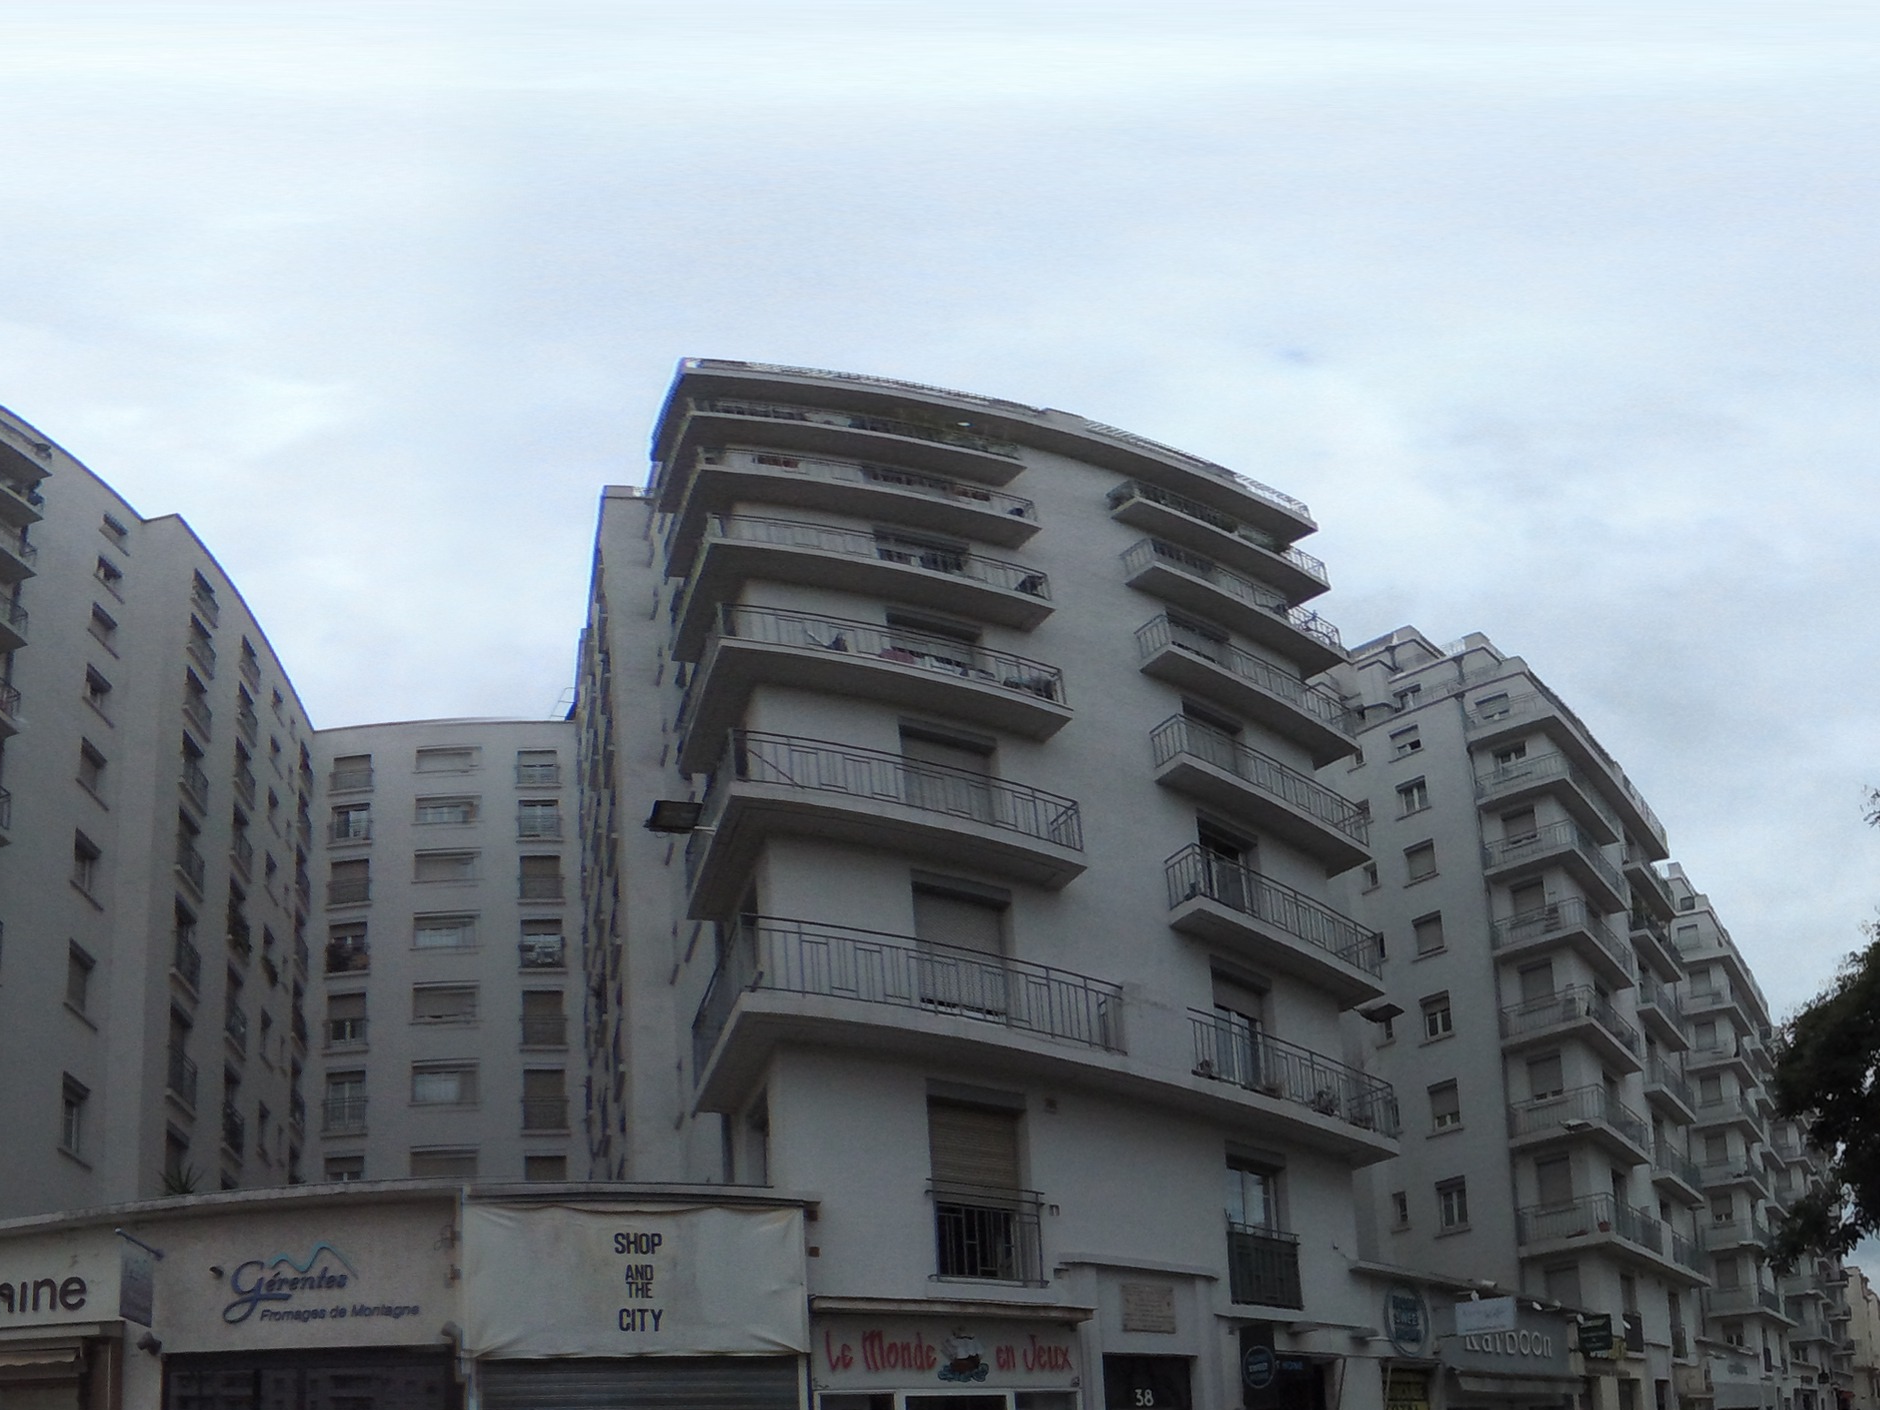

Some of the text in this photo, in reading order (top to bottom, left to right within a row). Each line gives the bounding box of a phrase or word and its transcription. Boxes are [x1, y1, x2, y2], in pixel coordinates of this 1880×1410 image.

[614, 1233, 662, 1254] SHOP
[625, 1264, 654, 1281] AND
[223, 1260, 348, 1324] Gérentes
[626, 1281, 653, 1299] THE
[260, 1304, 420, 1323] Fromages de Montagne
[618, 1308, 663, 1332] CITY
[825, 1329, 1073, 1372] Le Monde en Jeux
[1134, 1388, 1154, 1406] 38
